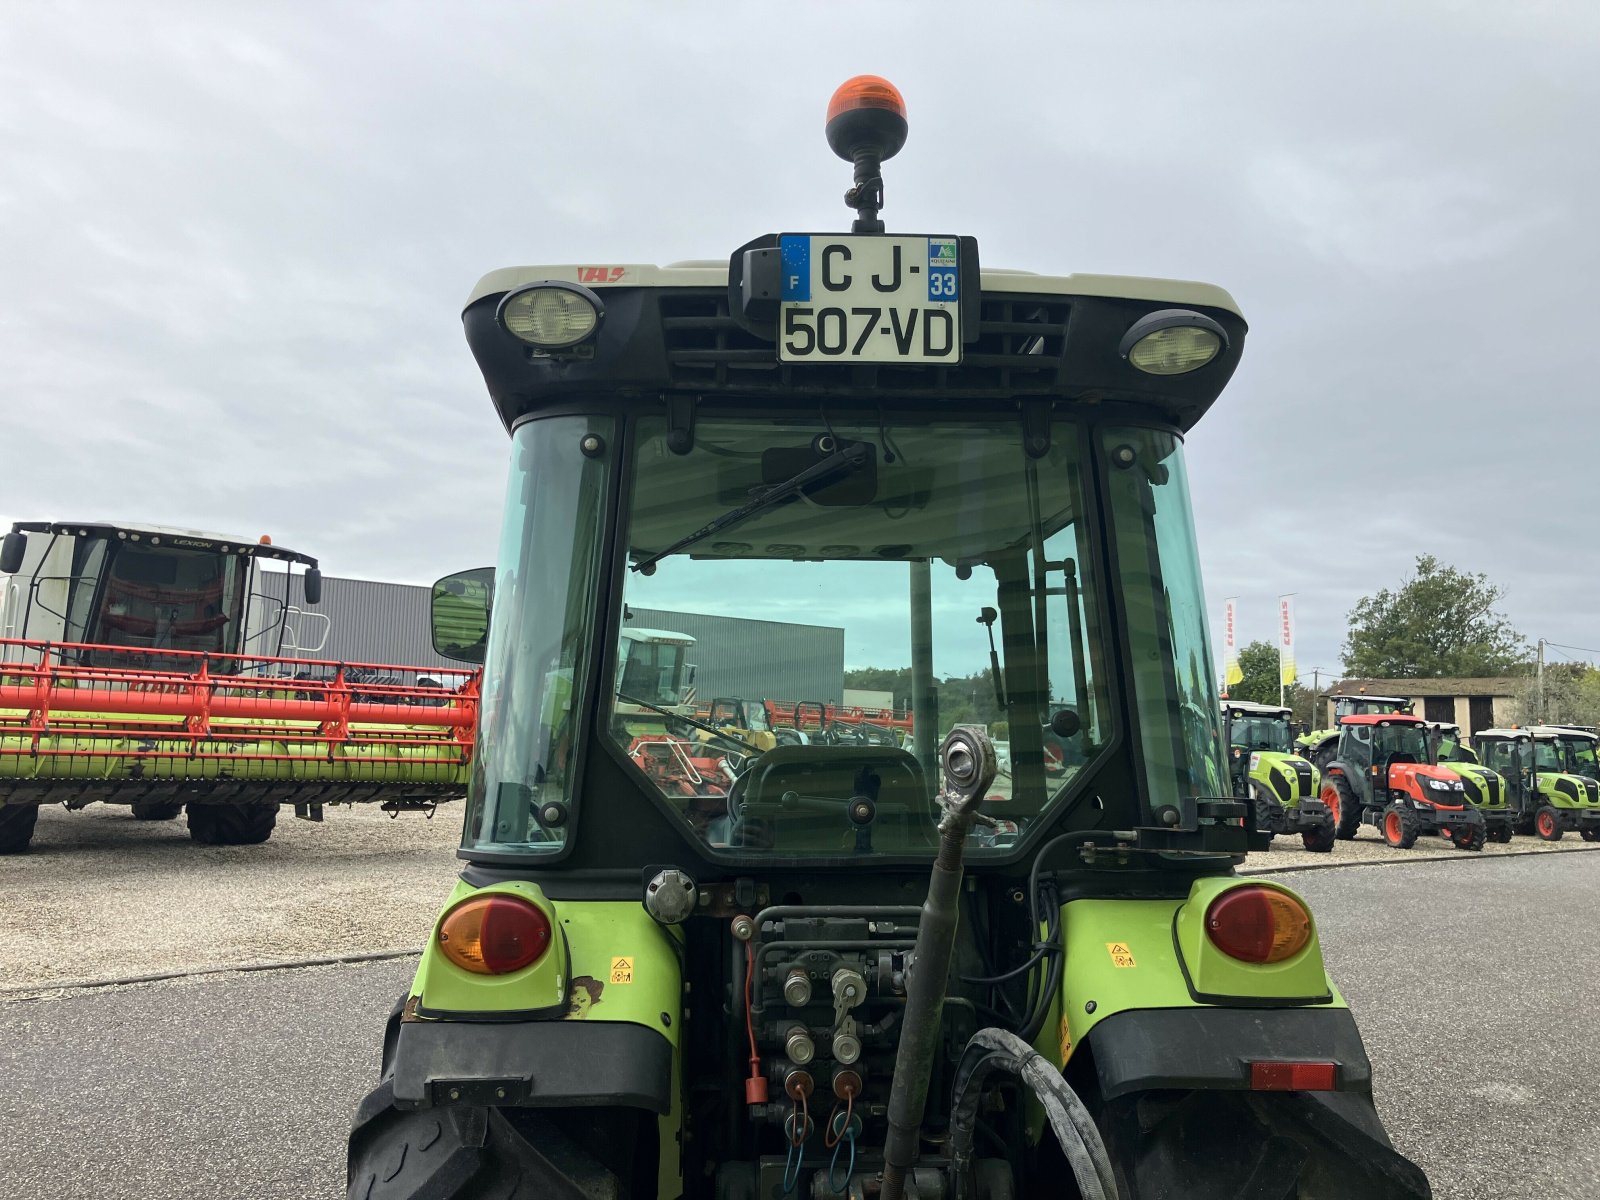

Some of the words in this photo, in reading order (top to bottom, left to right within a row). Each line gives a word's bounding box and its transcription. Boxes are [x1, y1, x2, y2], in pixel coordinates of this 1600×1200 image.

[789, 275, 800, 290] F
[930, 273, 956, 296] 33
[785, 307, 953, 357] 507-VD
[173, 538, 213, 549] LEXION
